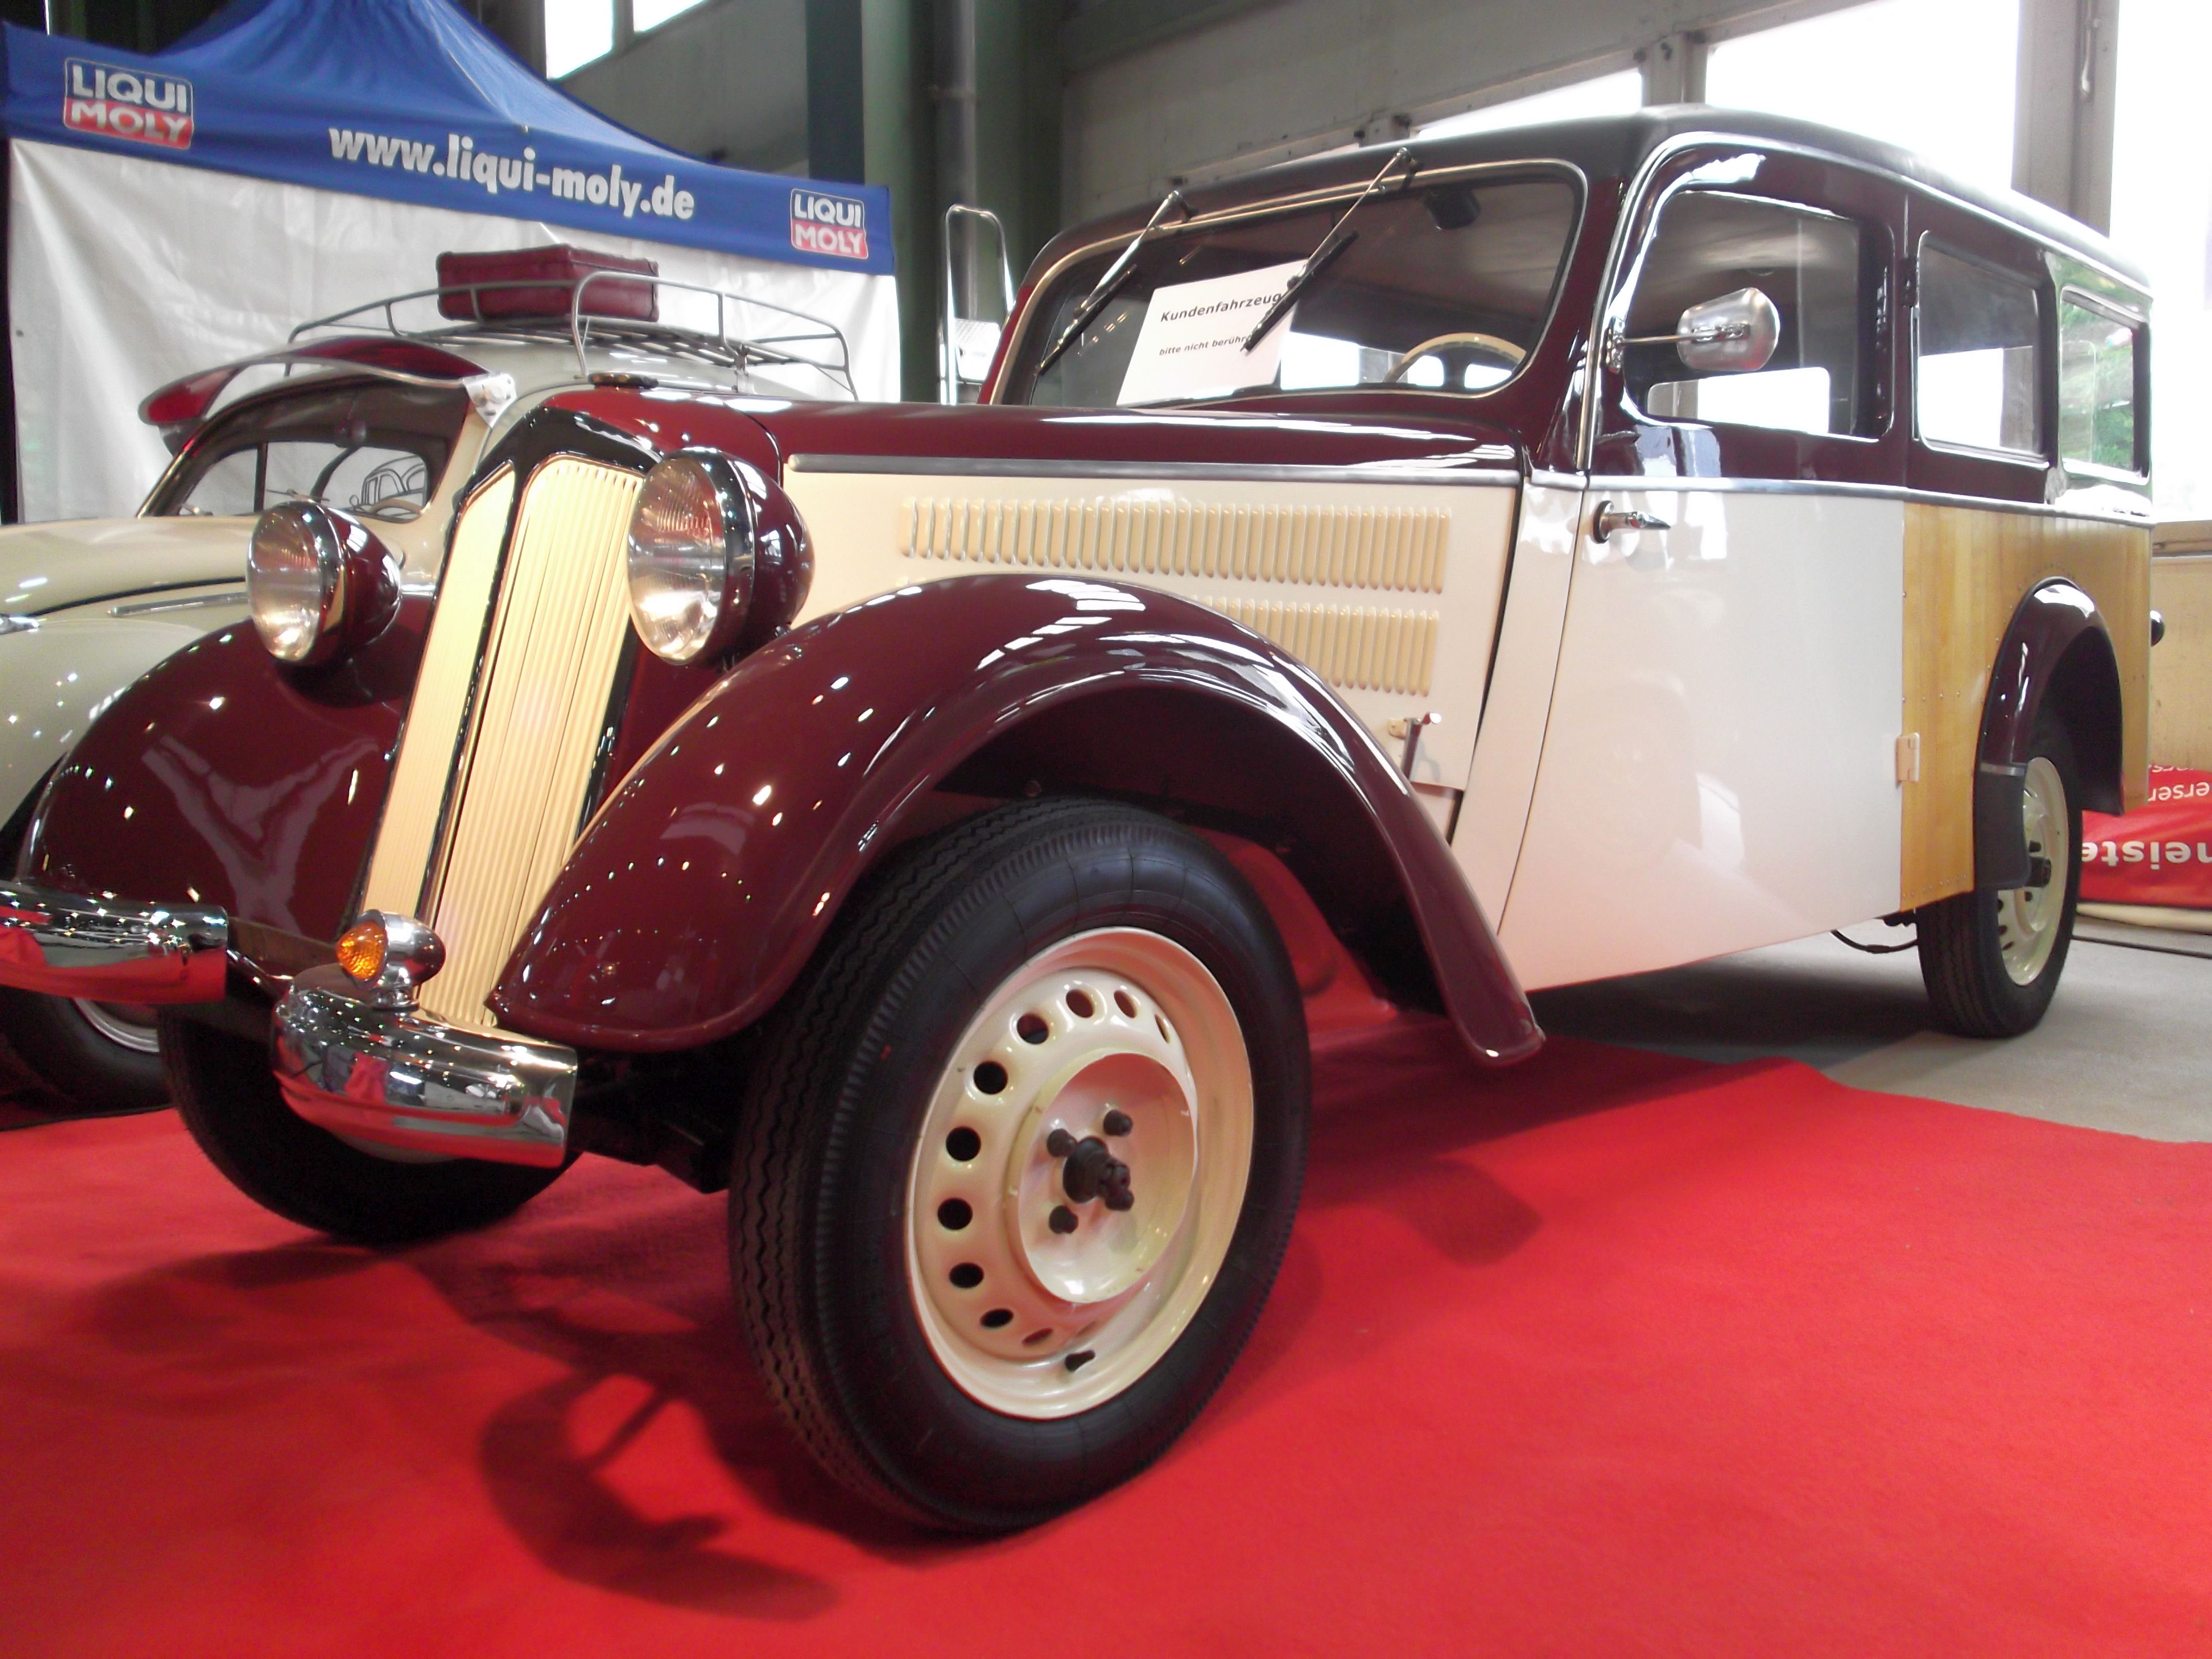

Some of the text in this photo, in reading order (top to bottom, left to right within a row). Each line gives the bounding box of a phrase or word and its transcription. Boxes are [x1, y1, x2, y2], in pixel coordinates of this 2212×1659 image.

[72, 64, 187, 113] LIQUI
[71, 100, 187, 143] MOLY
[329, 127, 695, 220] www.liqui-moly.de
[794, 193, 861, 228] LIQUI
[794, 223, 863, 254] MOLY
[1160, 292, 1282, 322] Kundenfahrzeug
[1159, 334, 1249, 356] bitte nicht berühr
